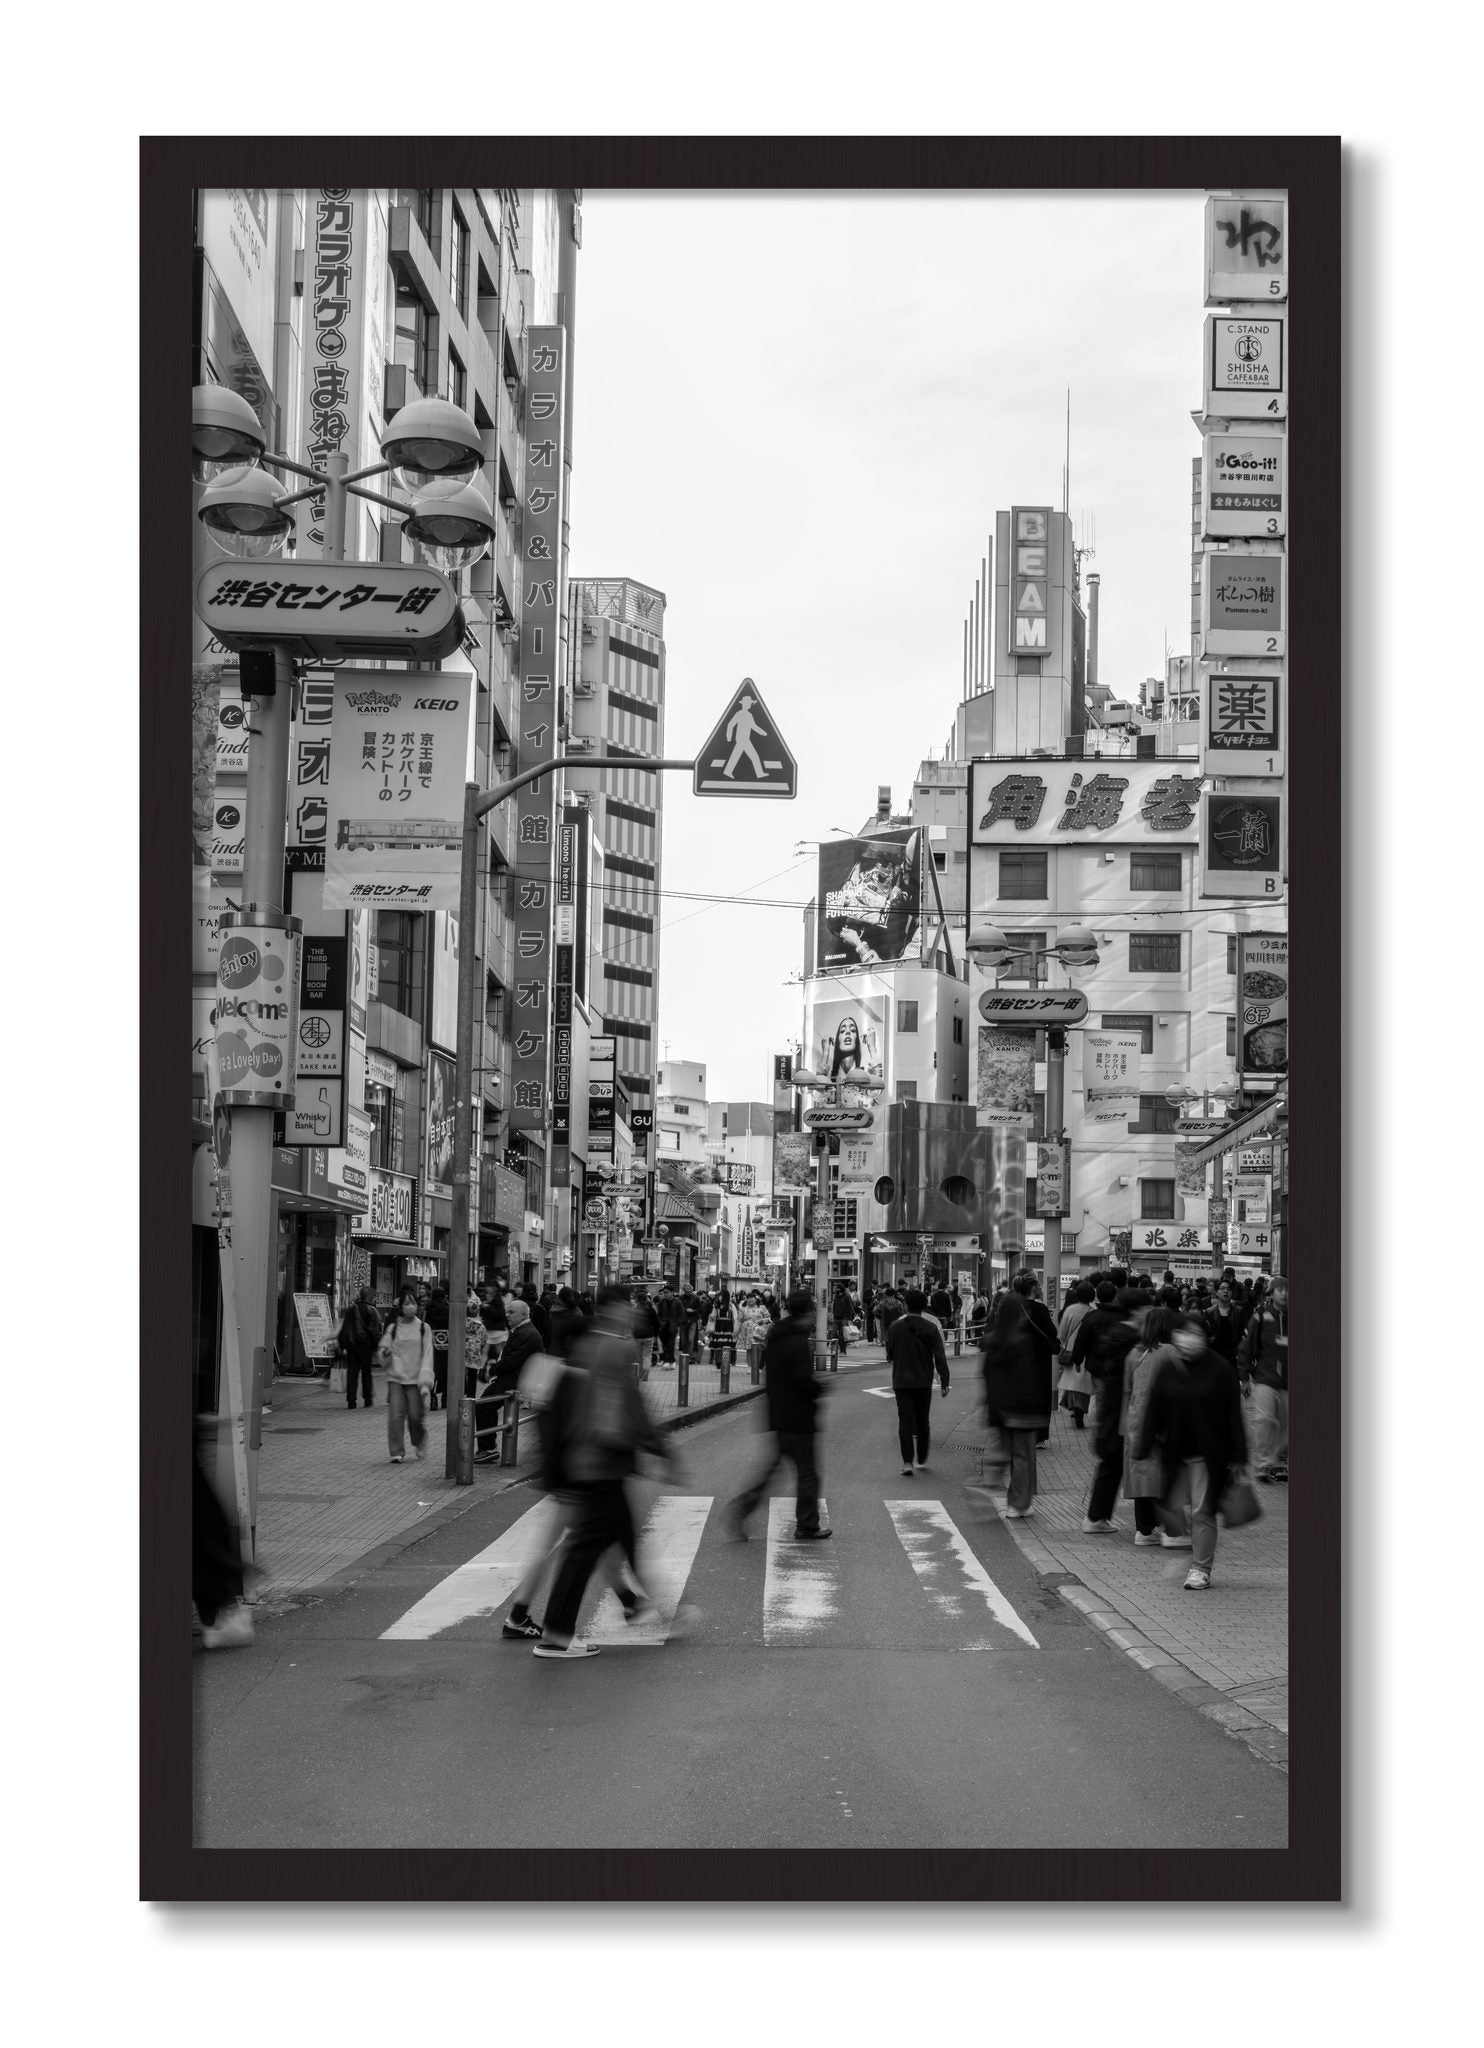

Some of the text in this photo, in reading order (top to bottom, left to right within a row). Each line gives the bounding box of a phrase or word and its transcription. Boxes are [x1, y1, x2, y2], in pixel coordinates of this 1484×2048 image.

[313, 201, 353, 331] カラオケ
[1269, 280, 1280, 295] 5
[1227, 325, 1270, 334] C.STAND
[1227, 363, 1269, 373] SHISHA
[1267, 399, 1279, 413] 4
[1219, 472, 1274, 482] 渋谷宇田川町店
[1215, 497, 1278, 508] 全身もみほぐし
[1267, 518, 1278, 534] 3
[1017, 511, 1047, 648] BEAM
[208, 579, 442, 615] 渋谷センター街
[1216, 585, 1275, 603] ポムの樹
[1266, 637, 1278, 652] 2
[413, 698, 459, 711] KEIO
[1218, 683, 1266, 731] 薬
[361, 731, 377, 772] 冒険へ
[220, 758, 244, 766] 渋谷店
[378, 731, 396, 802] カントーの
[418, 733, 434, 789] 京王線で
[1265, 757, 1275, 773] 1
[979, 774, 1201, 831] 角海老
[562, 829, 571, 862] kimono
[216, 858, 240, 868] 渋谷店
[349, 884, 433, 897] 渋谷センター街
[1264, 878, 1276, 893] B
[221, 950, 258, 982] Enjoy
[514, 882, 547, 1109] カラオケ館
[216, 996, 288, 1020] Welcome
[985, 998, 1081, 1010] 渋谷センター街
[1244, 1006, 1271, 1024] 6F
[232, 1050, 260, 1070] Lovely
[262, 1051, 280, 1065] Day!
[295, 1112, 327, 1123] Whisky
[633, 1116, 652, 1126] GU
[807, 1113, 864, 1121] 渋谷センター街
[1145, 1228, 1200, 1248] 兆楽
